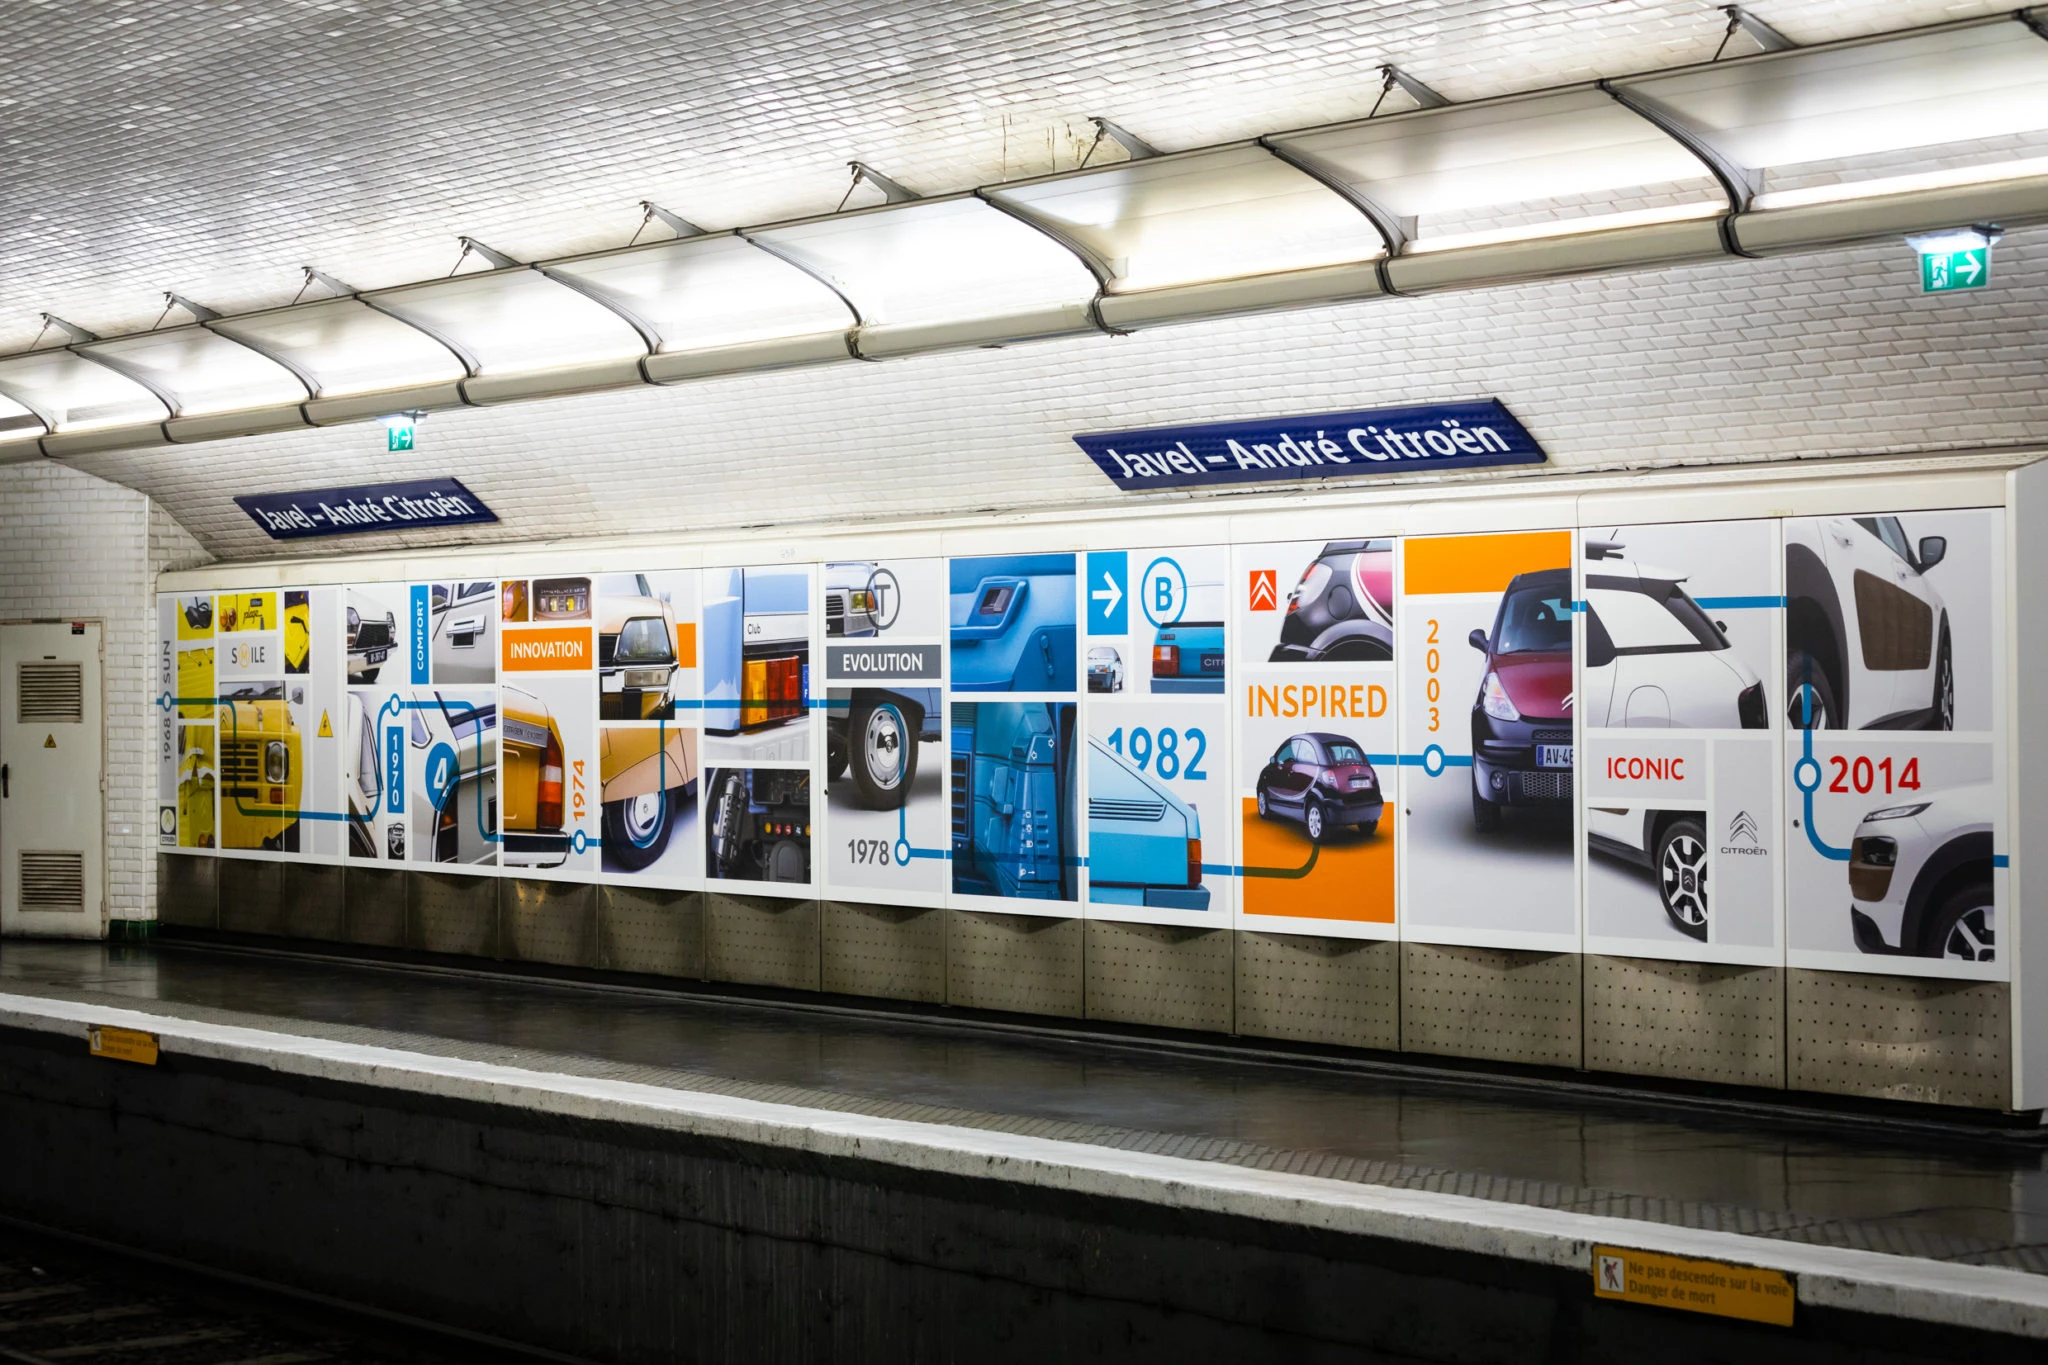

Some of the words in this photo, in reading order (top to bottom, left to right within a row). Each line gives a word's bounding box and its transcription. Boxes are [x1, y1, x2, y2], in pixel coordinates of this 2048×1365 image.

[1107, 441, 1207, 480] Javel
[1226, 429, 1352, 470] André
[1348, 418, 1511, 461] Citroën
[256, 503, 315, 531] Javel
[318, 497, 391, 526] André
[382, 490, 476, 521] Citroën
[874, 584, 891, 617] T
[1155, 576, 1173, 612] B
[416, 598, 424, 671] COMFORT
[747, 623, 761, 635] Club
[163, 640, 171, 685] SUN
[231, 644, 266, 666] SMILE
[510, 641, 583, 659] INNOVATION
[843, 653, 923, 672] EVOLUTION
[1427, 619, 1441, 732] 2003
[1248, 684, 1388, 719] INSPIRED
[163, 717, 171, 763] 1968
[1107, 726, 1207, 780] 1982
[391, 733, 400, 807] 1970
[1607, 757, 1685, 781] ICONIC
[1829, 755, 1921, 795] 2014
[572, 759, 585, 822] 1974
[848, 839, 890, 866] 1978
[1628, 1261, 1644, 1276] Ne
[1647, 1265, 1666, 1280] pas
[1669, 1266, 1726, 1288] descendre
[1729, 1278, 1747, 1290] sur
[1750, 1277, 1762, 1293] la
[1764, 1282, 1790, 1298] voie
[1628, 1279, 1669, 1300] Danger
[1671, 1286, 1686, 1301] de
[1688, 1291, 1717, 1305] mort
